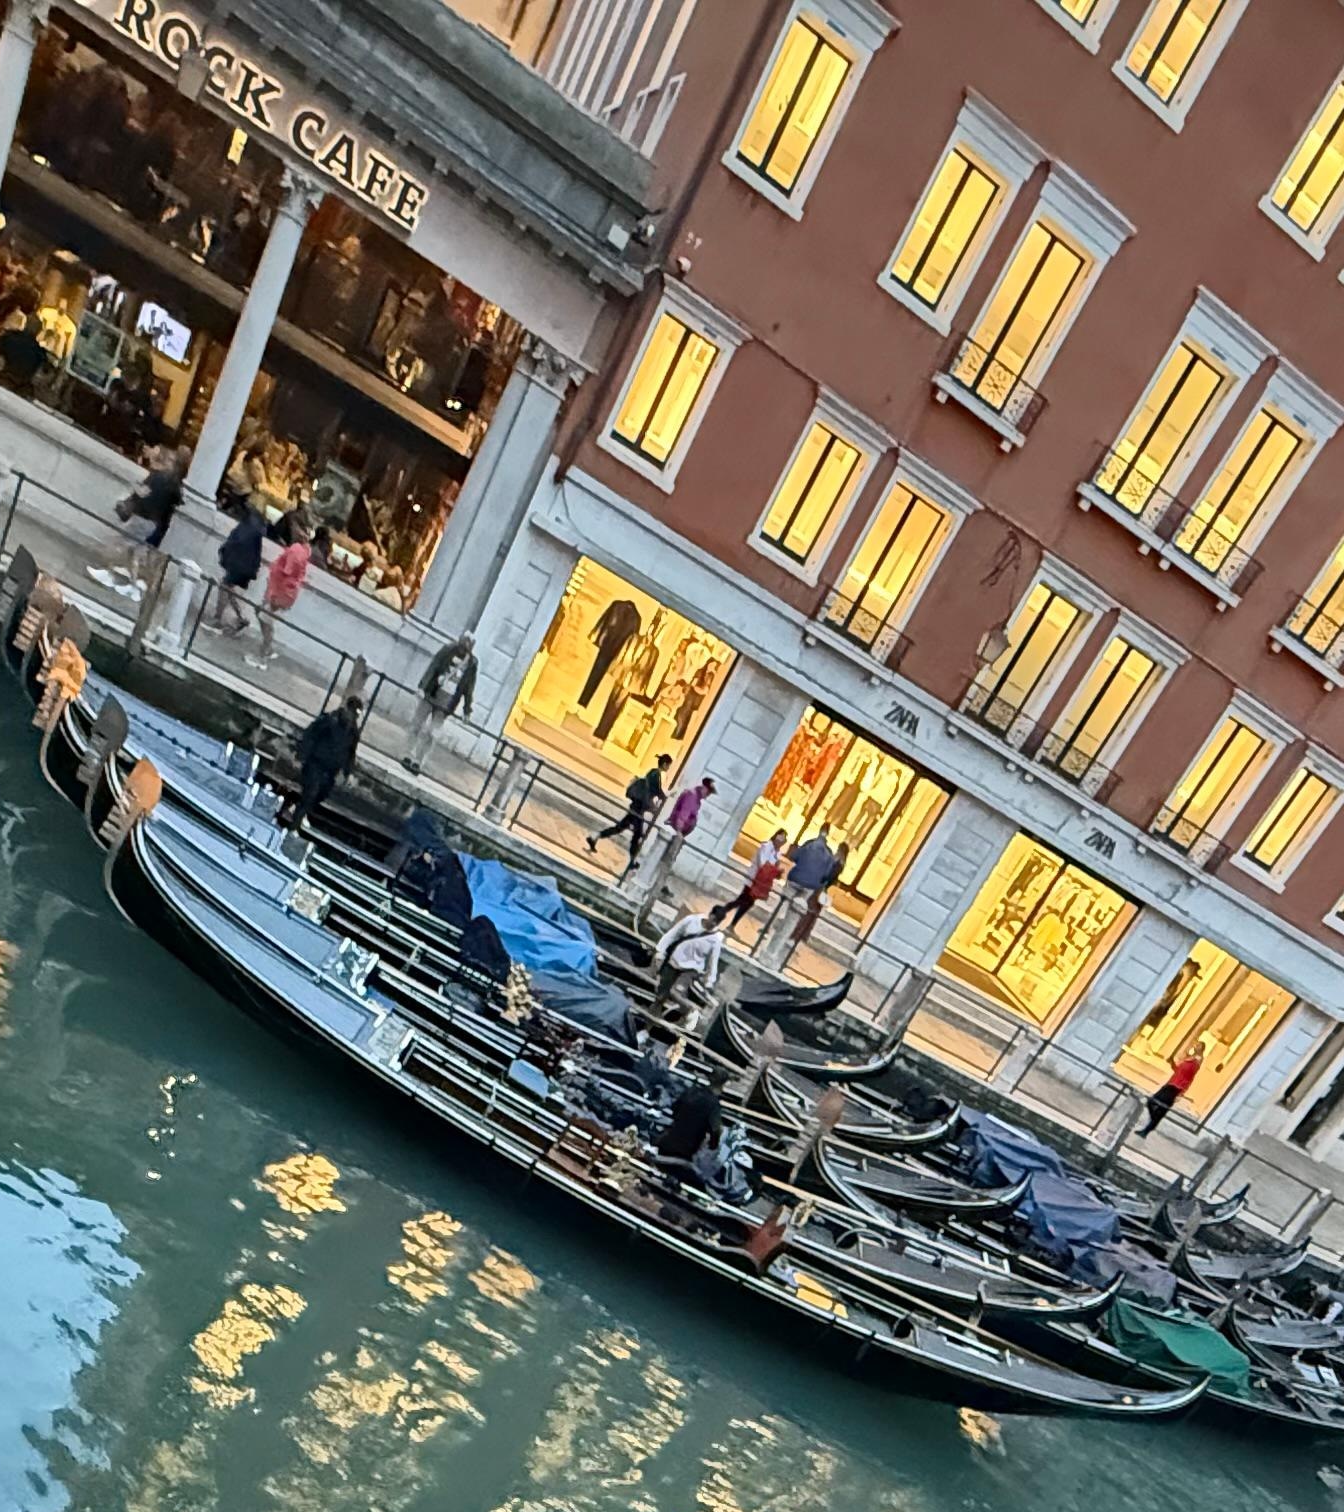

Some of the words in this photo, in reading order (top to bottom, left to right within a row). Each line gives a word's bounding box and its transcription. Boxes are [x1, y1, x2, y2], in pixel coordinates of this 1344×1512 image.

[112, 0, 282, 128] ROCK
[291, 109, 426, 229] CAFE
[884, 700, 920, 738] ZARA
[1083, 827, 1117, 861] ZARA
